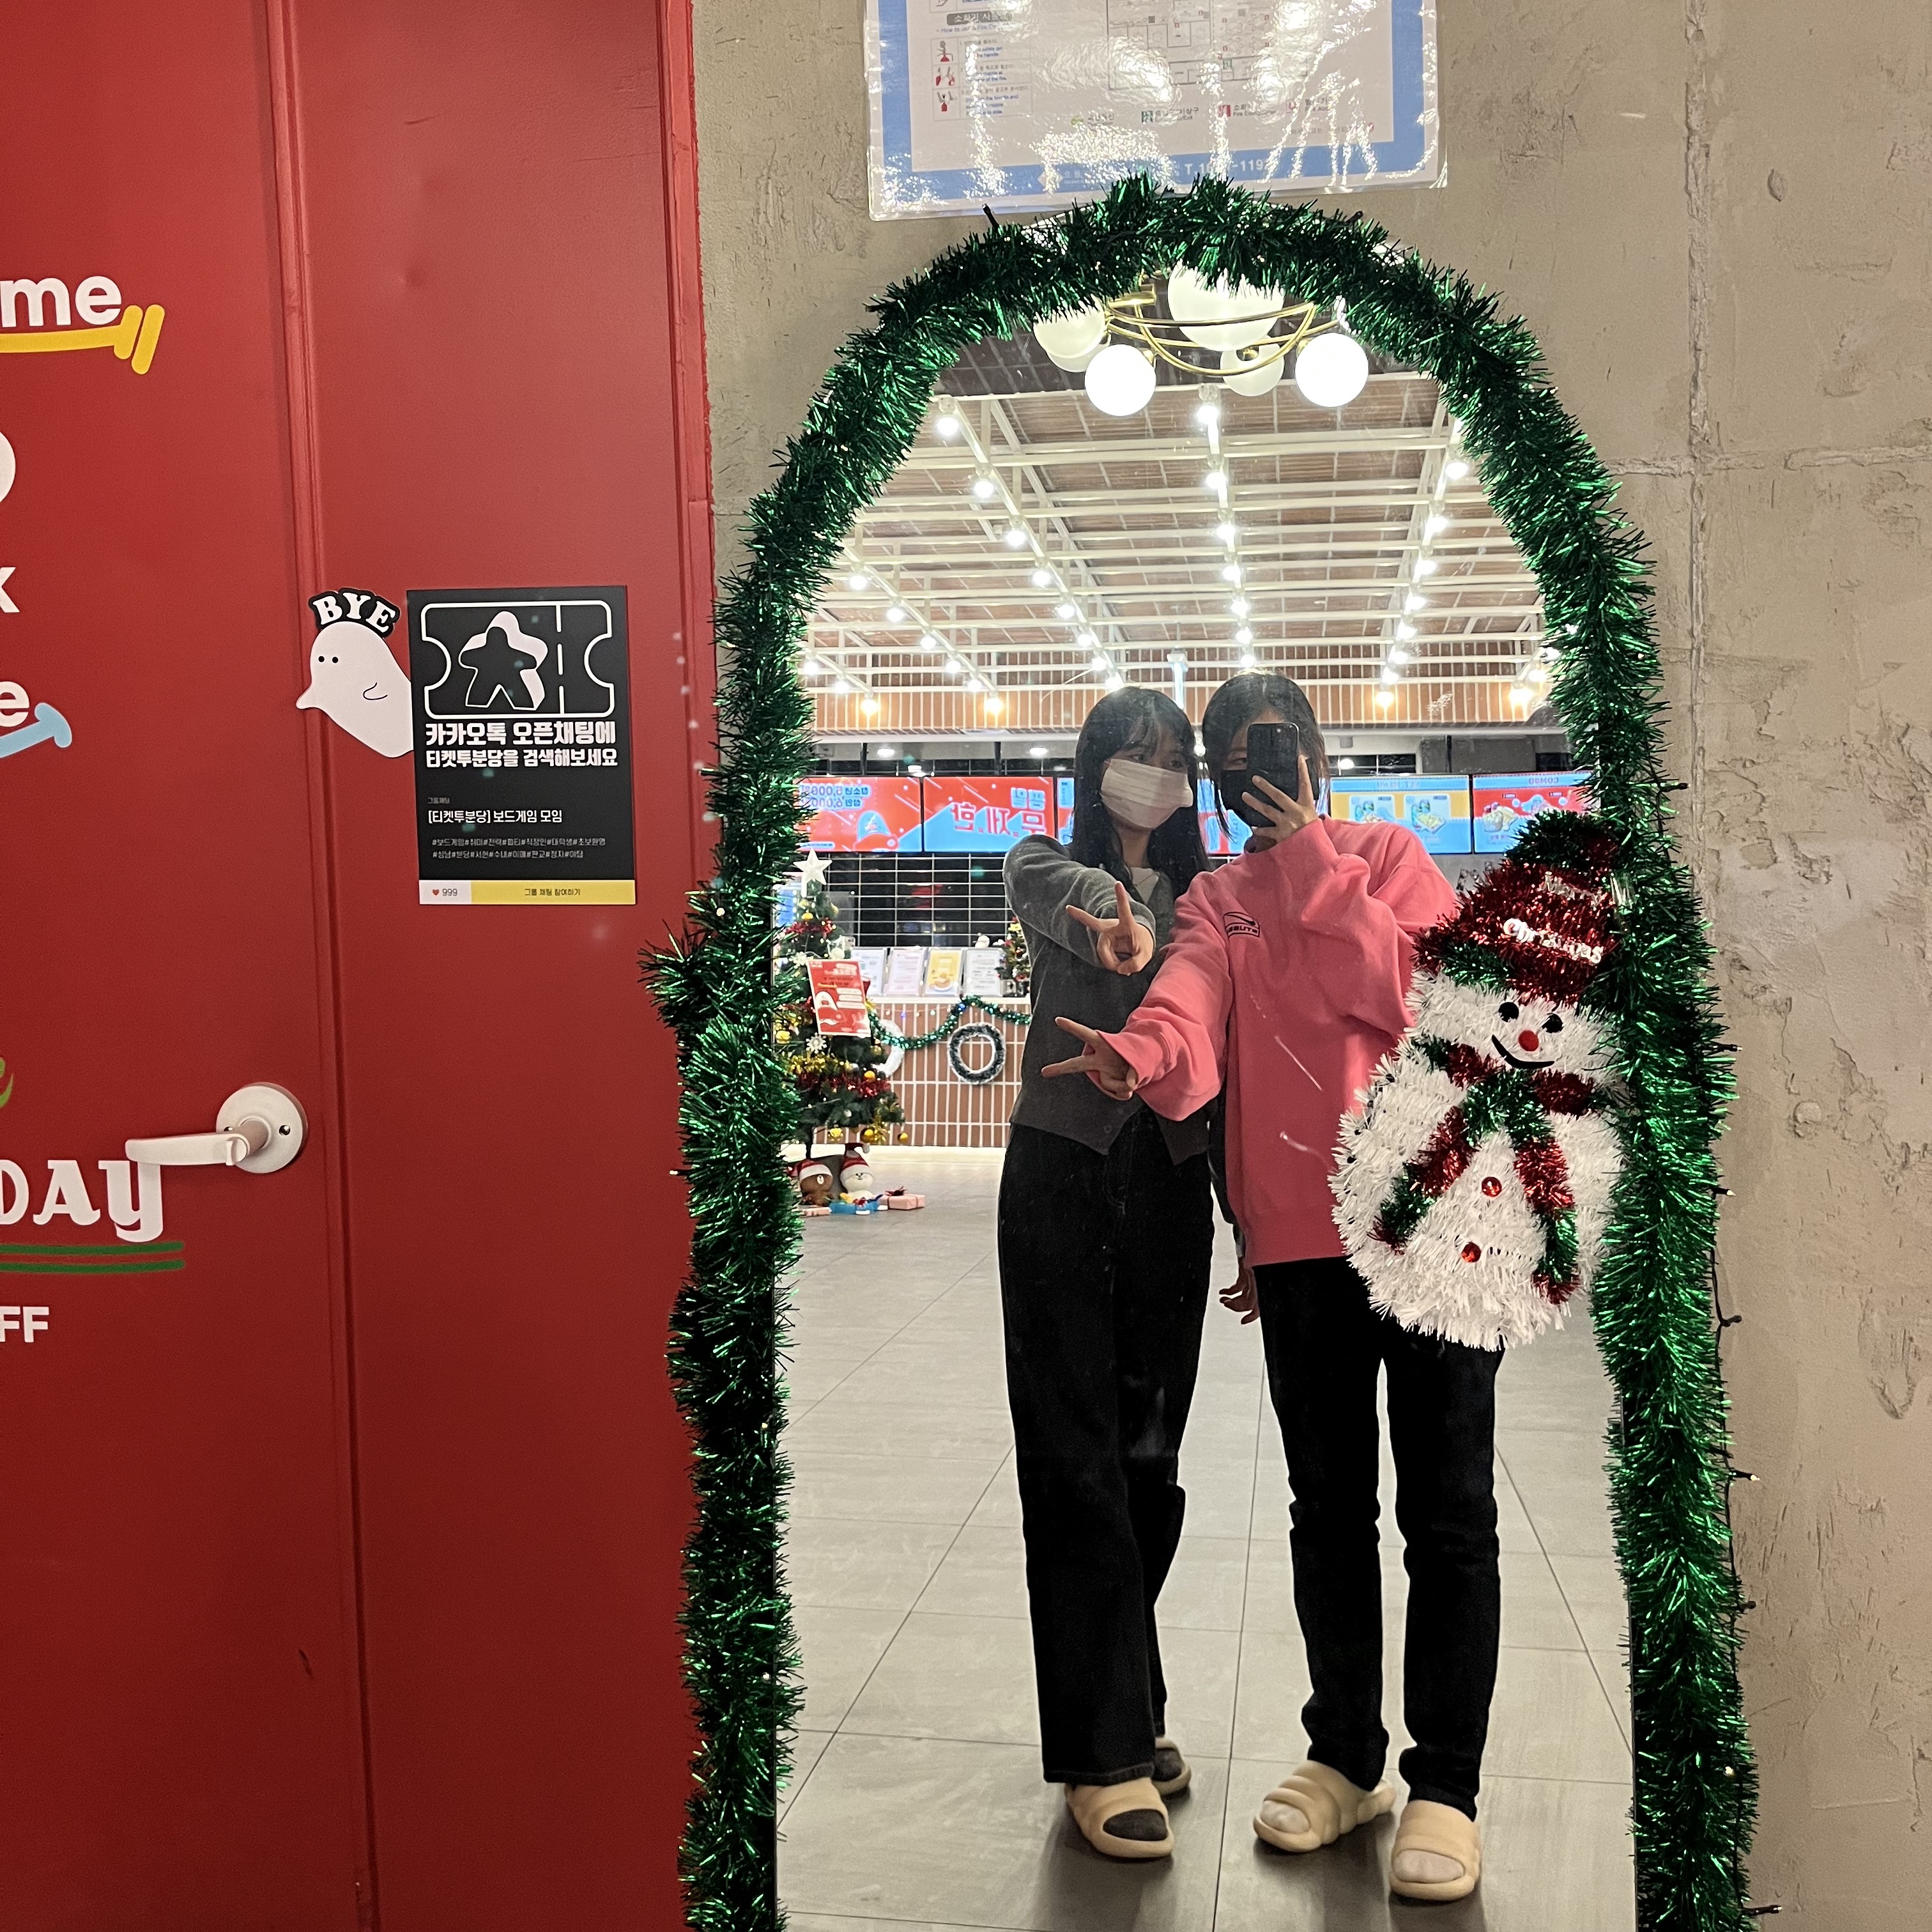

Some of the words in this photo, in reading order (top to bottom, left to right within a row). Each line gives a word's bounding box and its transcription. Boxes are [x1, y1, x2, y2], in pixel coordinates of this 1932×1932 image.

[312, 592, 396, 632] BYE
[425, 723, 507, 746] 카카오톡
[512, 721, 616, 745] 오픈채팅에
[425, 749, 519, 768] 티켓투분당을
[523, 748, 618, 767] 검색해보세요
[428, 809, 491, 824] [티켓투분당]
[493, 809, 537, 823] 보드게임
[540, 809, 562, 823] 모임
[442, 888, 457, 896] 999
